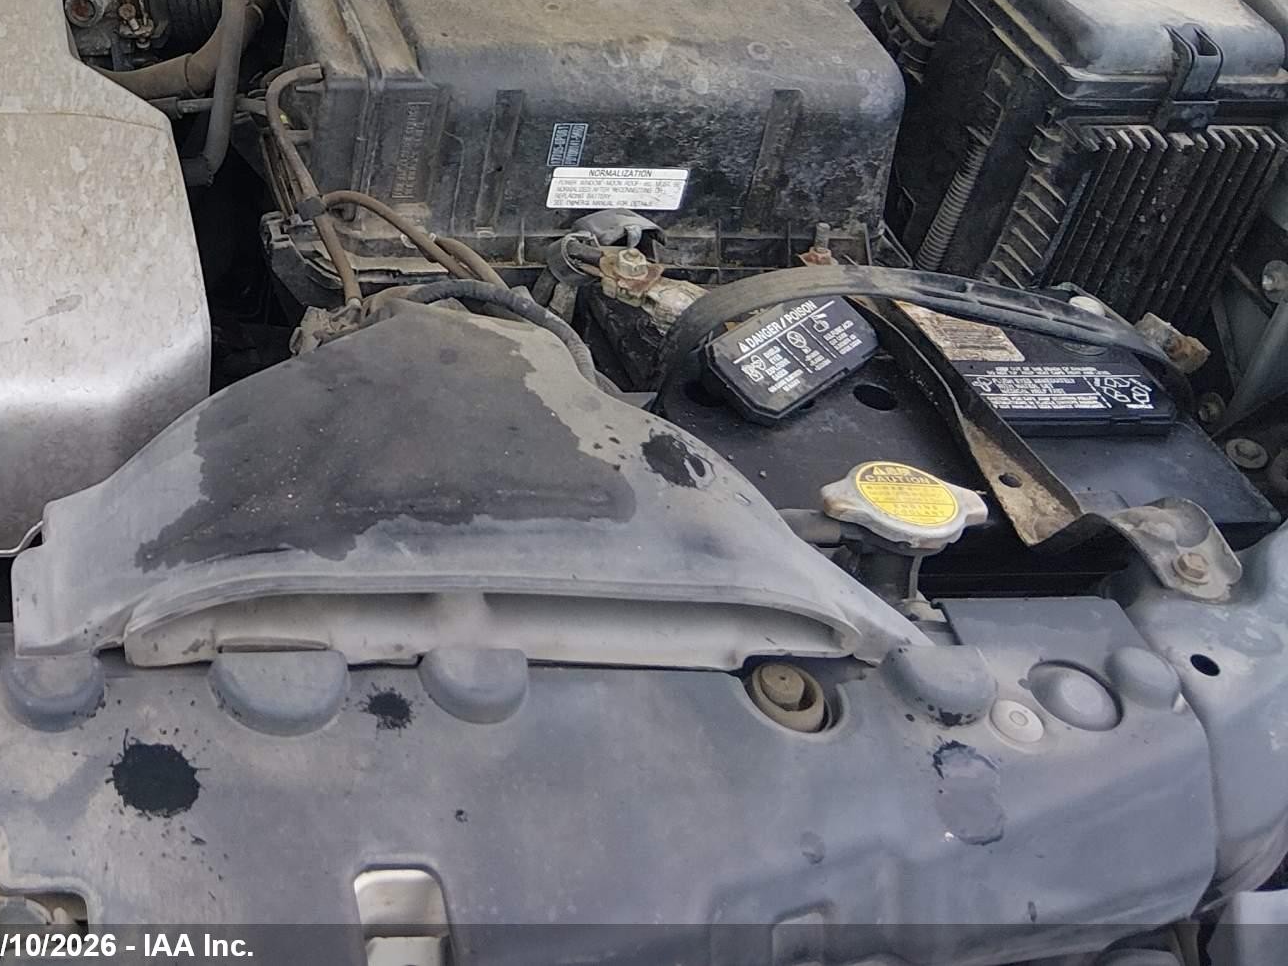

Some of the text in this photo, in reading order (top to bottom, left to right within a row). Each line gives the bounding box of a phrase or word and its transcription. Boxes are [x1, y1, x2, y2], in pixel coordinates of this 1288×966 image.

[588, 169, 653, 178] NORMALIZATION
[745, 321, 783, 348] DANGER
[785, 300, 818, 323] POISON
[864, 474, 930, 485] CAUTION
